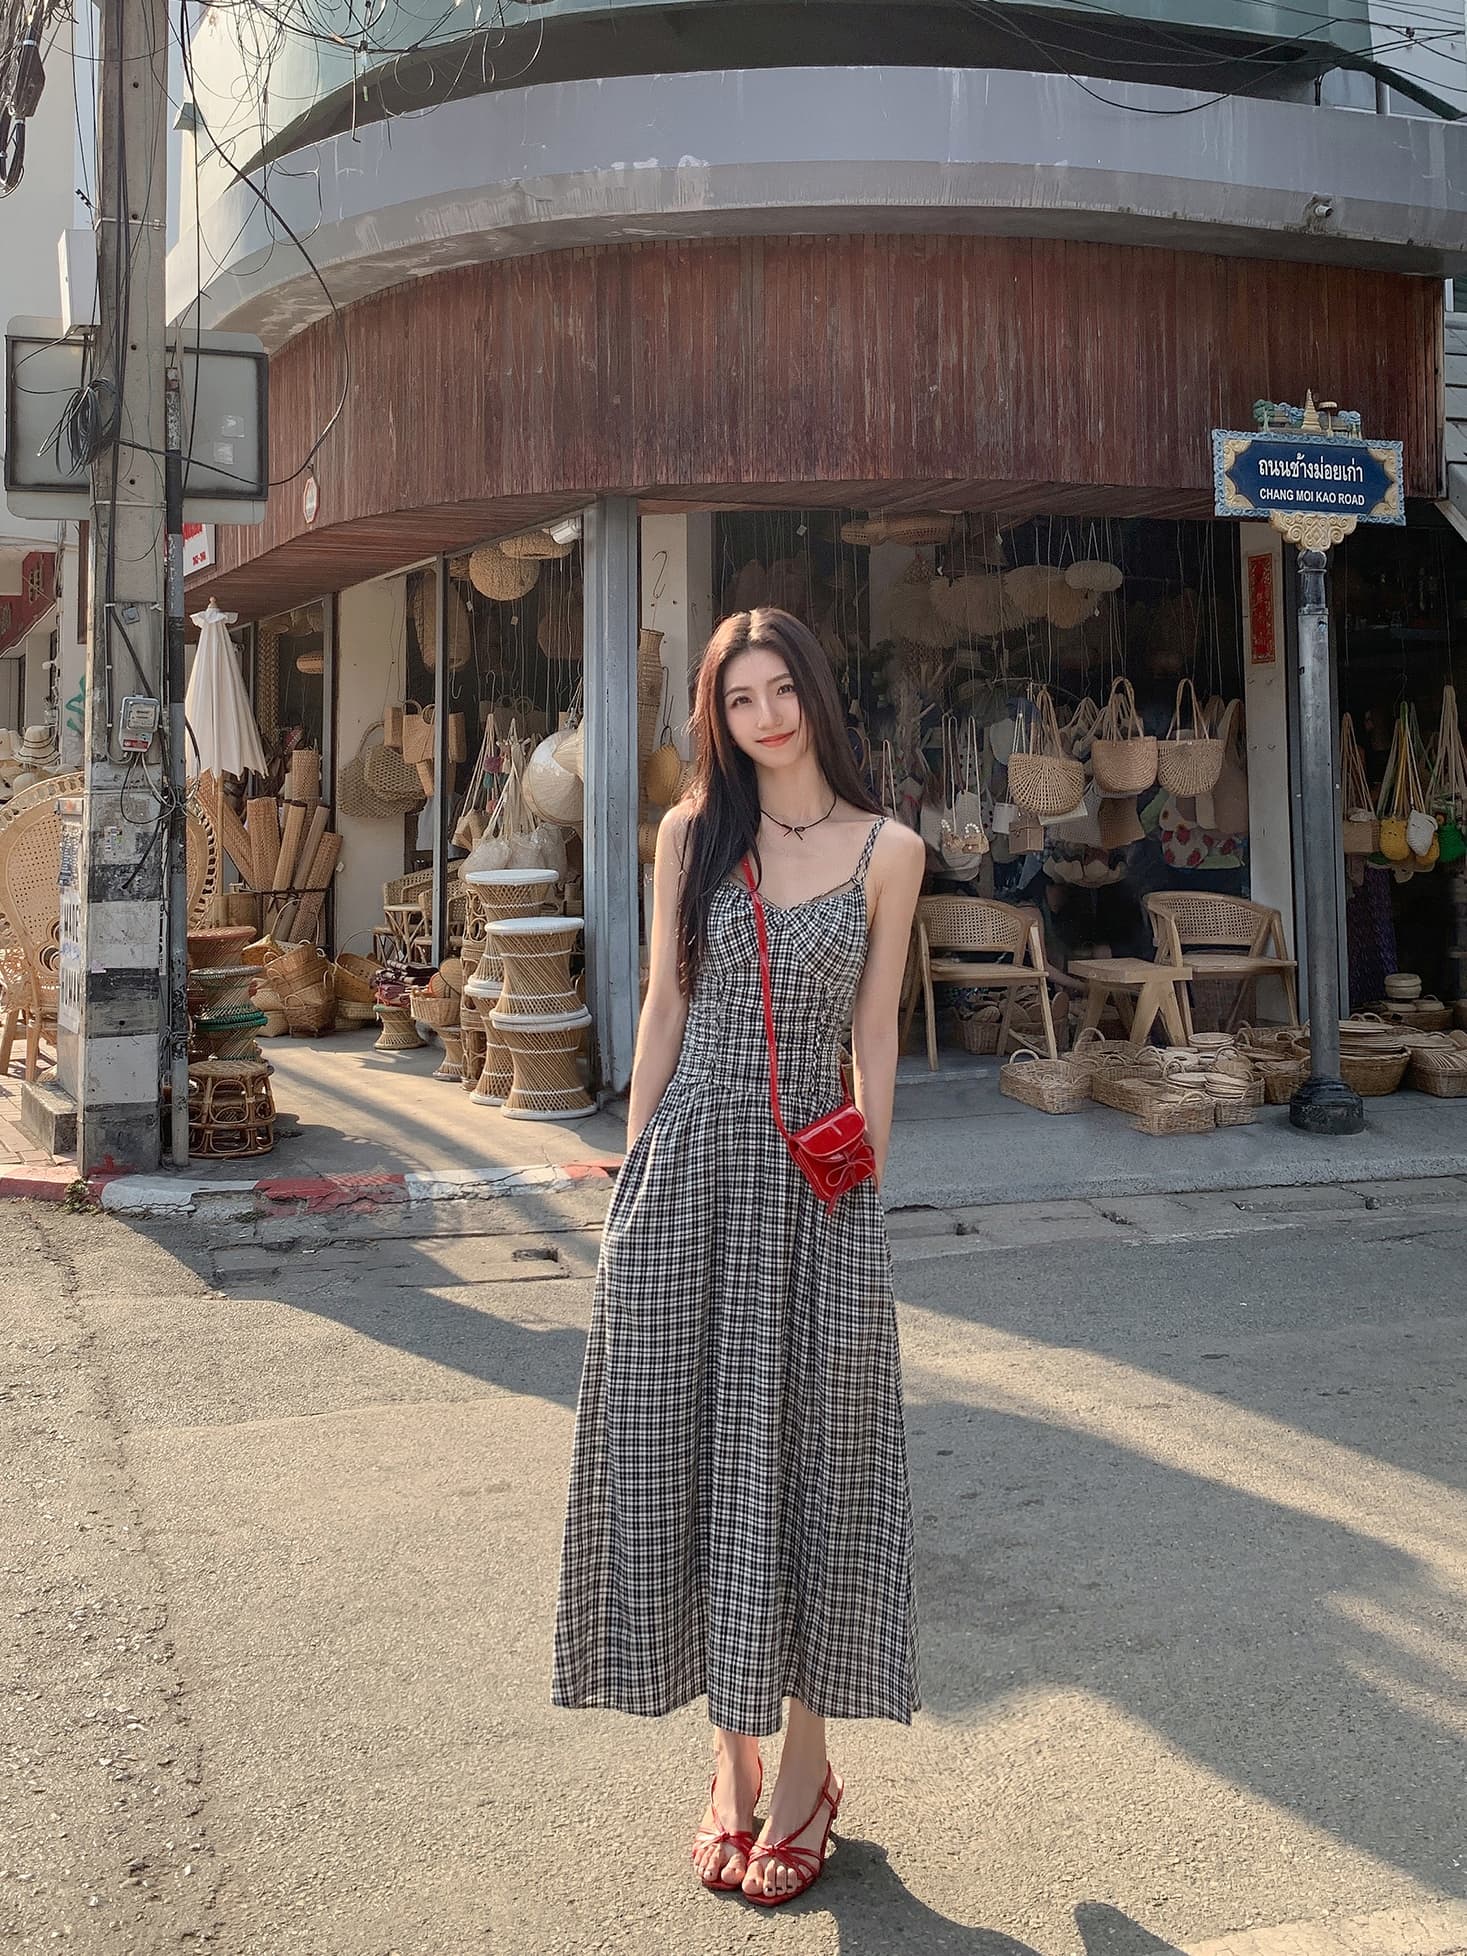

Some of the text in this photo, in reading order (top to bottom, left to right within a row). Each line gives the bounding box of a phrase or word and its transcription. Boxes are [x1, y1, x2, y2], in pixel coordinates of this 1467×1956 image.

[1258, 452, 1364, 483] ถนนช้างม่อยเก่า
[1259, 488, 1365, 506] CHANG MOI KAO ROAD
